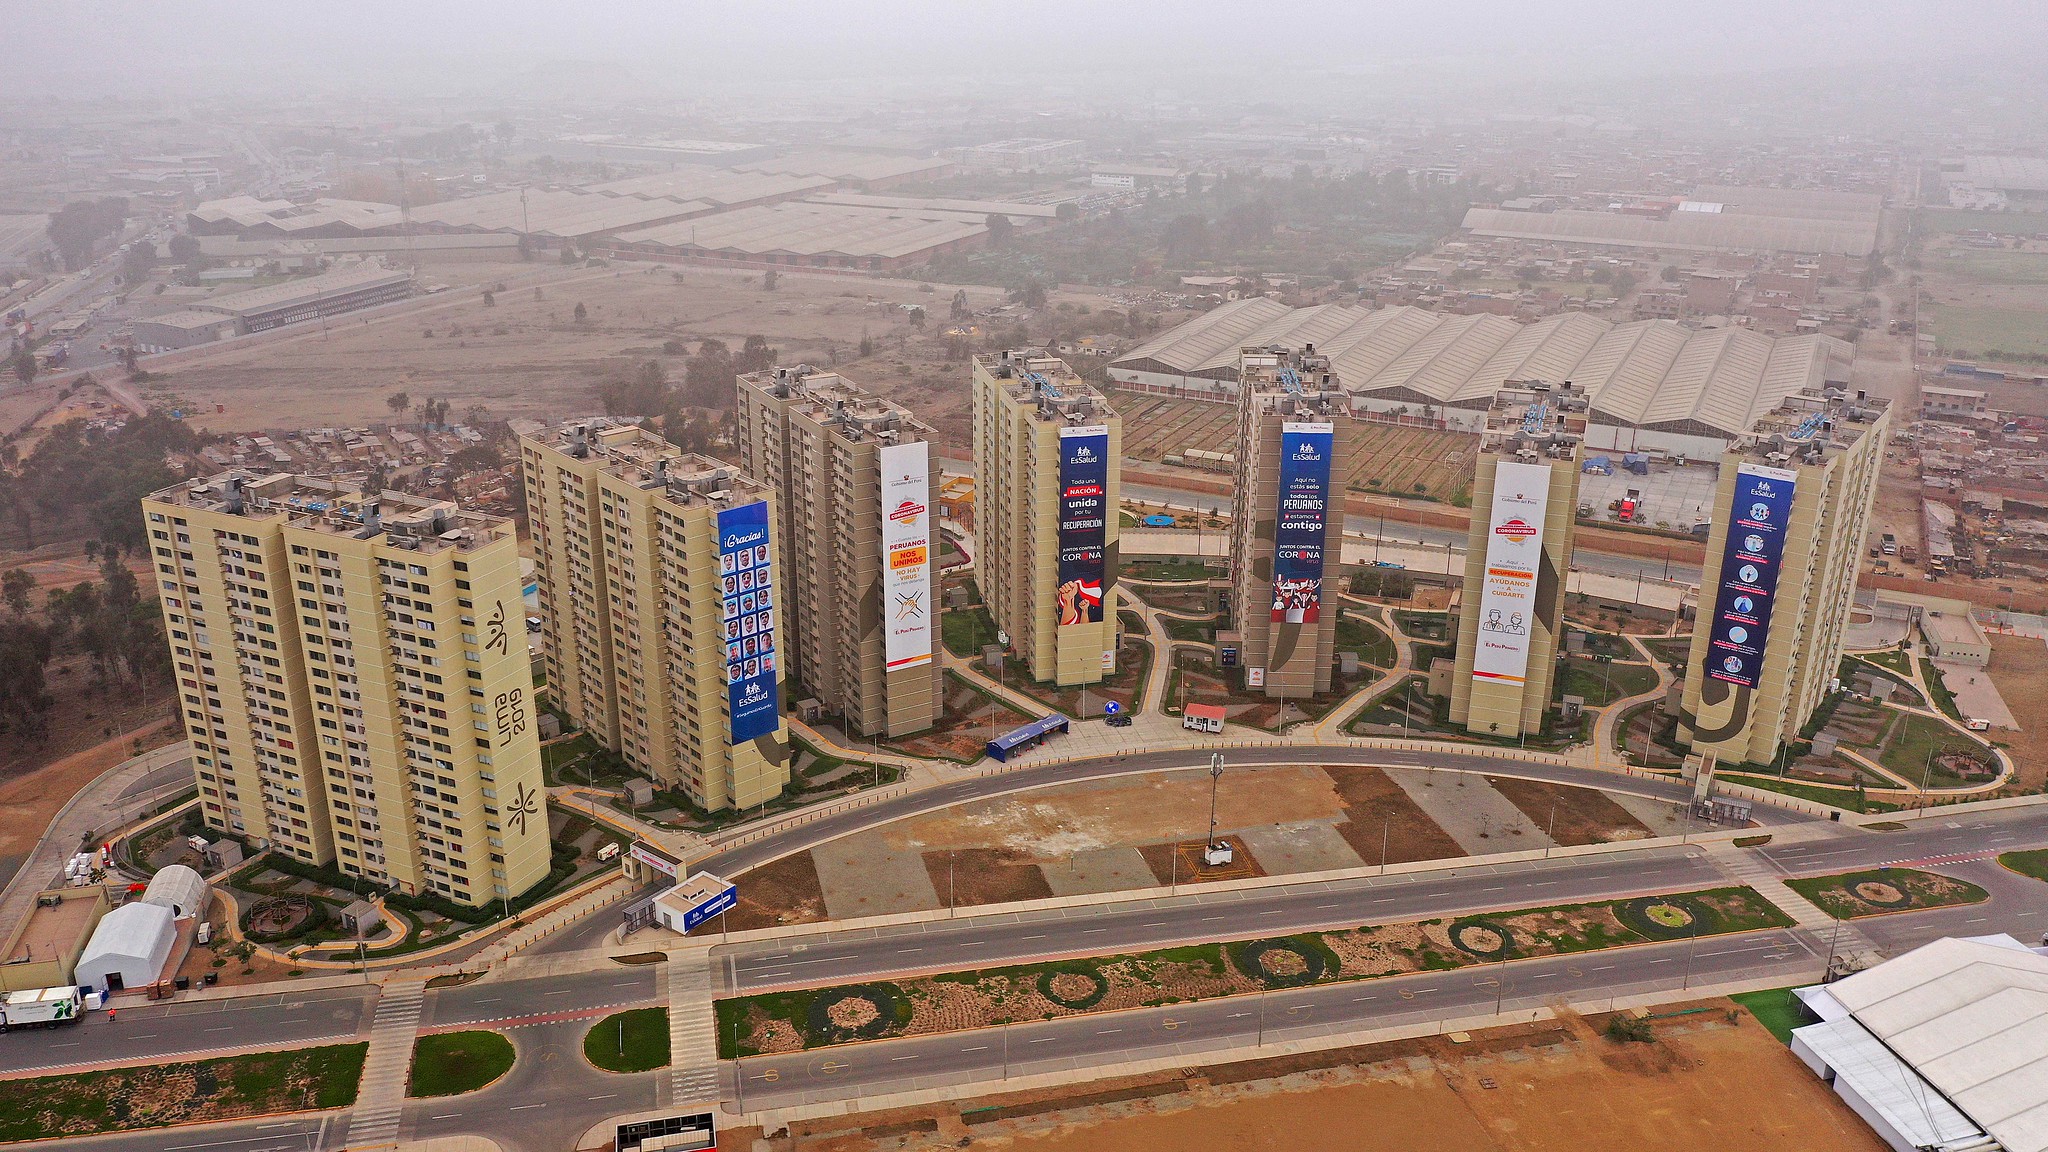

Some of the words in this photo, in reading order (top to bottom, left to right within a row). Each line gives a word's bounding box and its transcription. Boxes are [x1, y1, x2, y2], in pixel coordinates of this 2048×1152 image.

[1070, 456, 1097, 464] EsSalud
[1751, 488, 1775, 498] EsSalud
[1069, 498, 1098, 508] unida
[1283, 500, 1323, 509] PERUANOS
[892, 507, 924, 518] CORONAVIRUS
[1063, 518, 1102, 530] RECUPERACIÓN
[1281, 521, 1322, 532] contigo
[724, 528, 764, 548] ¡Gracias!
[890, 539, 926, 550] PERUANOS
[1062, 552, 1101, 561] CORONA
[1279, 551, 1320, 559] CORONA
[894, 556, 923, 567] UNIMOS
[1492, 590, 1525, 598] CUIDARTE
[739, 690, 768, 707] EsSalud
[510, 688, 525, 735] 2019
[494, 693, 511, 747] Lima
